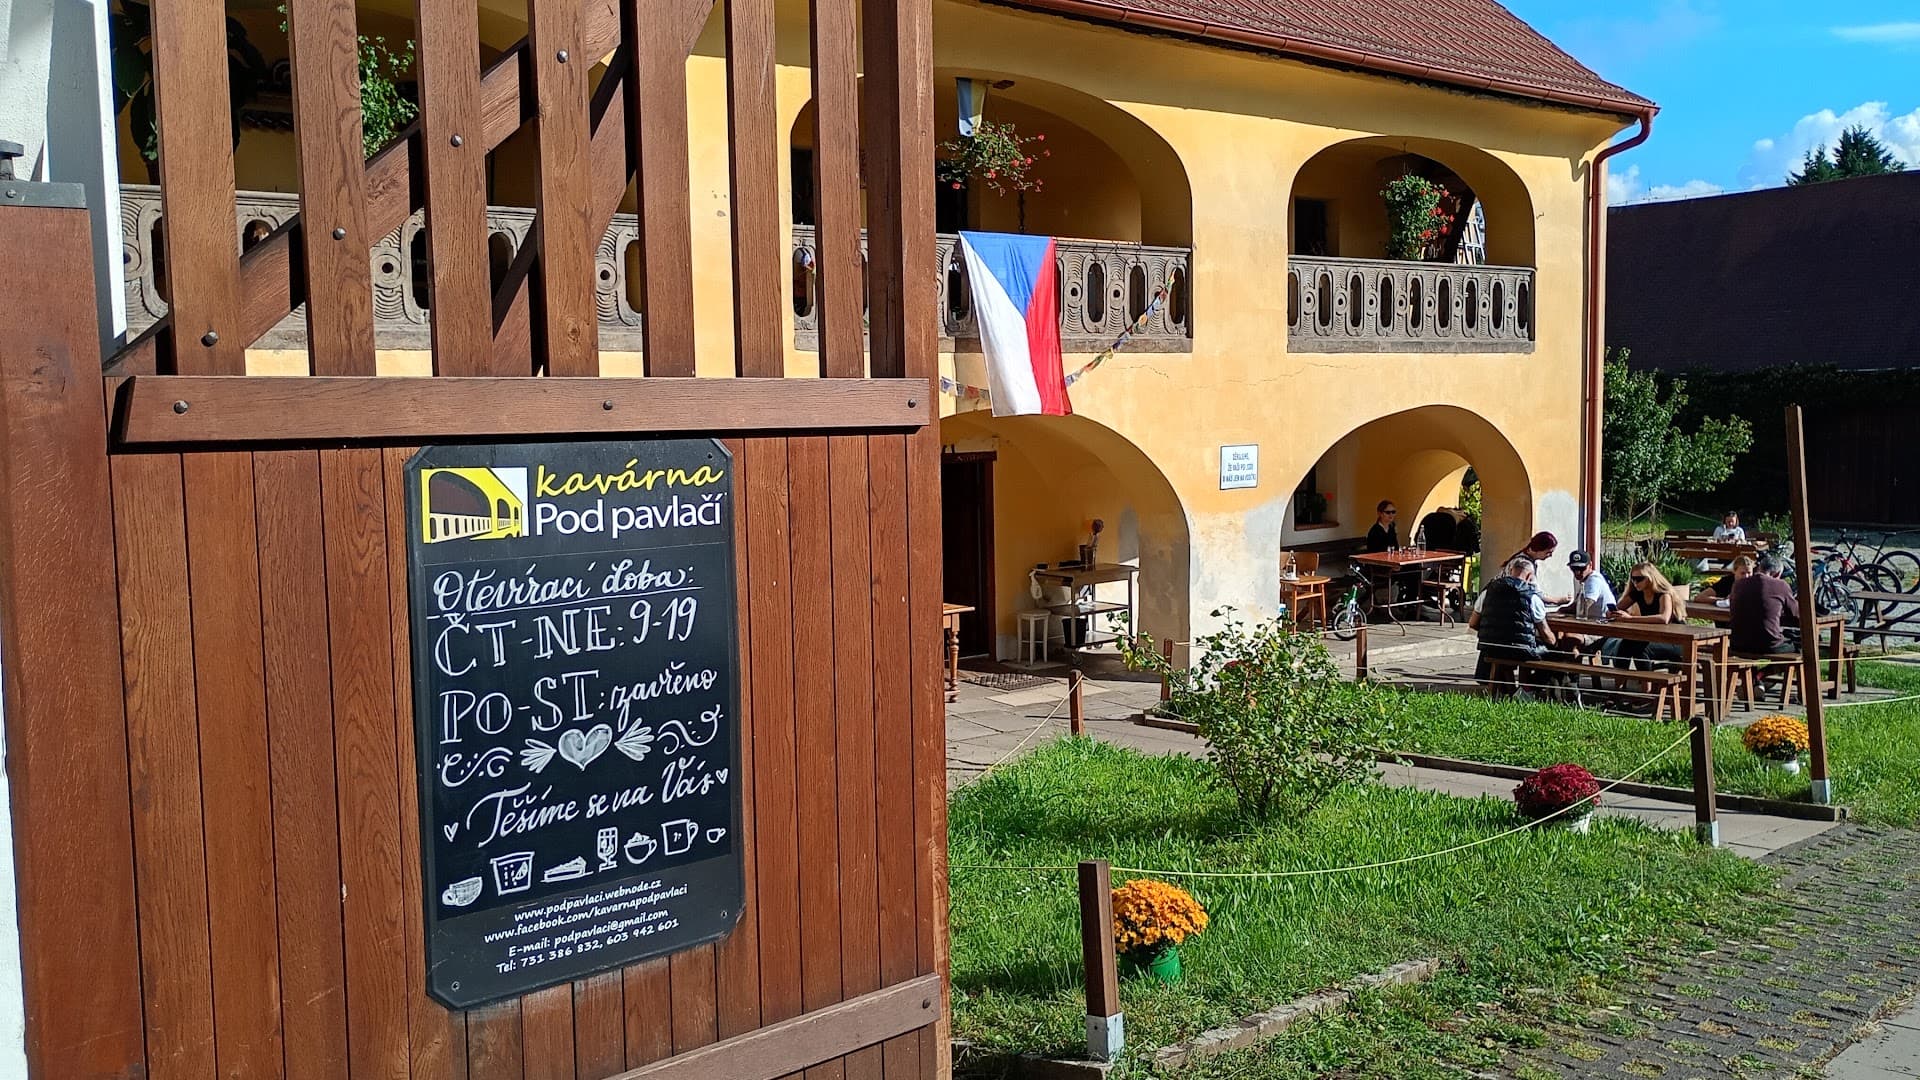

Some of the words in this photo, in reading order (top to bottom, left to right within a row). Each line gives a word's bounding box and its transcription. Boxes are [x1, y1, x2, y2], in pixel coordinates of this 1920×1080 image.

[536, 458, 724, 498] kavárna
[535, 499, 604, 536] Pod
[612, 493, 722, 539] pavlačí
[433, 561, 591, 612] Otevírací
[602, 558, 695, 594] doba:
[629, 596, 698, 643] 9-19
[608, 661, 718, 733] zavřeno
[466, 782, 580, 848] Těšíme
[585, 791, 609, 818] se
[612, 785, 656, 812] na
[484, 884, 689, 943] www.facebook.com/kavarnapodpavlaci
[514, 879, 663, 922] www.podpavlaci.webnode.cz
[496, 960, 517, 975] Tel:
[520, 953, 546, 968] 731
[549, 947, 573, 961] 386
[577, 939, 603, 954] 832,
[606, 931, 629, 945] 603
[632, 924, 655, 939] 942
[658, 917, 680, 932] 601
[508, 938, 551, 957] E-mail:
[554, 909, 669, 949] podpavlaci@gmail.com
